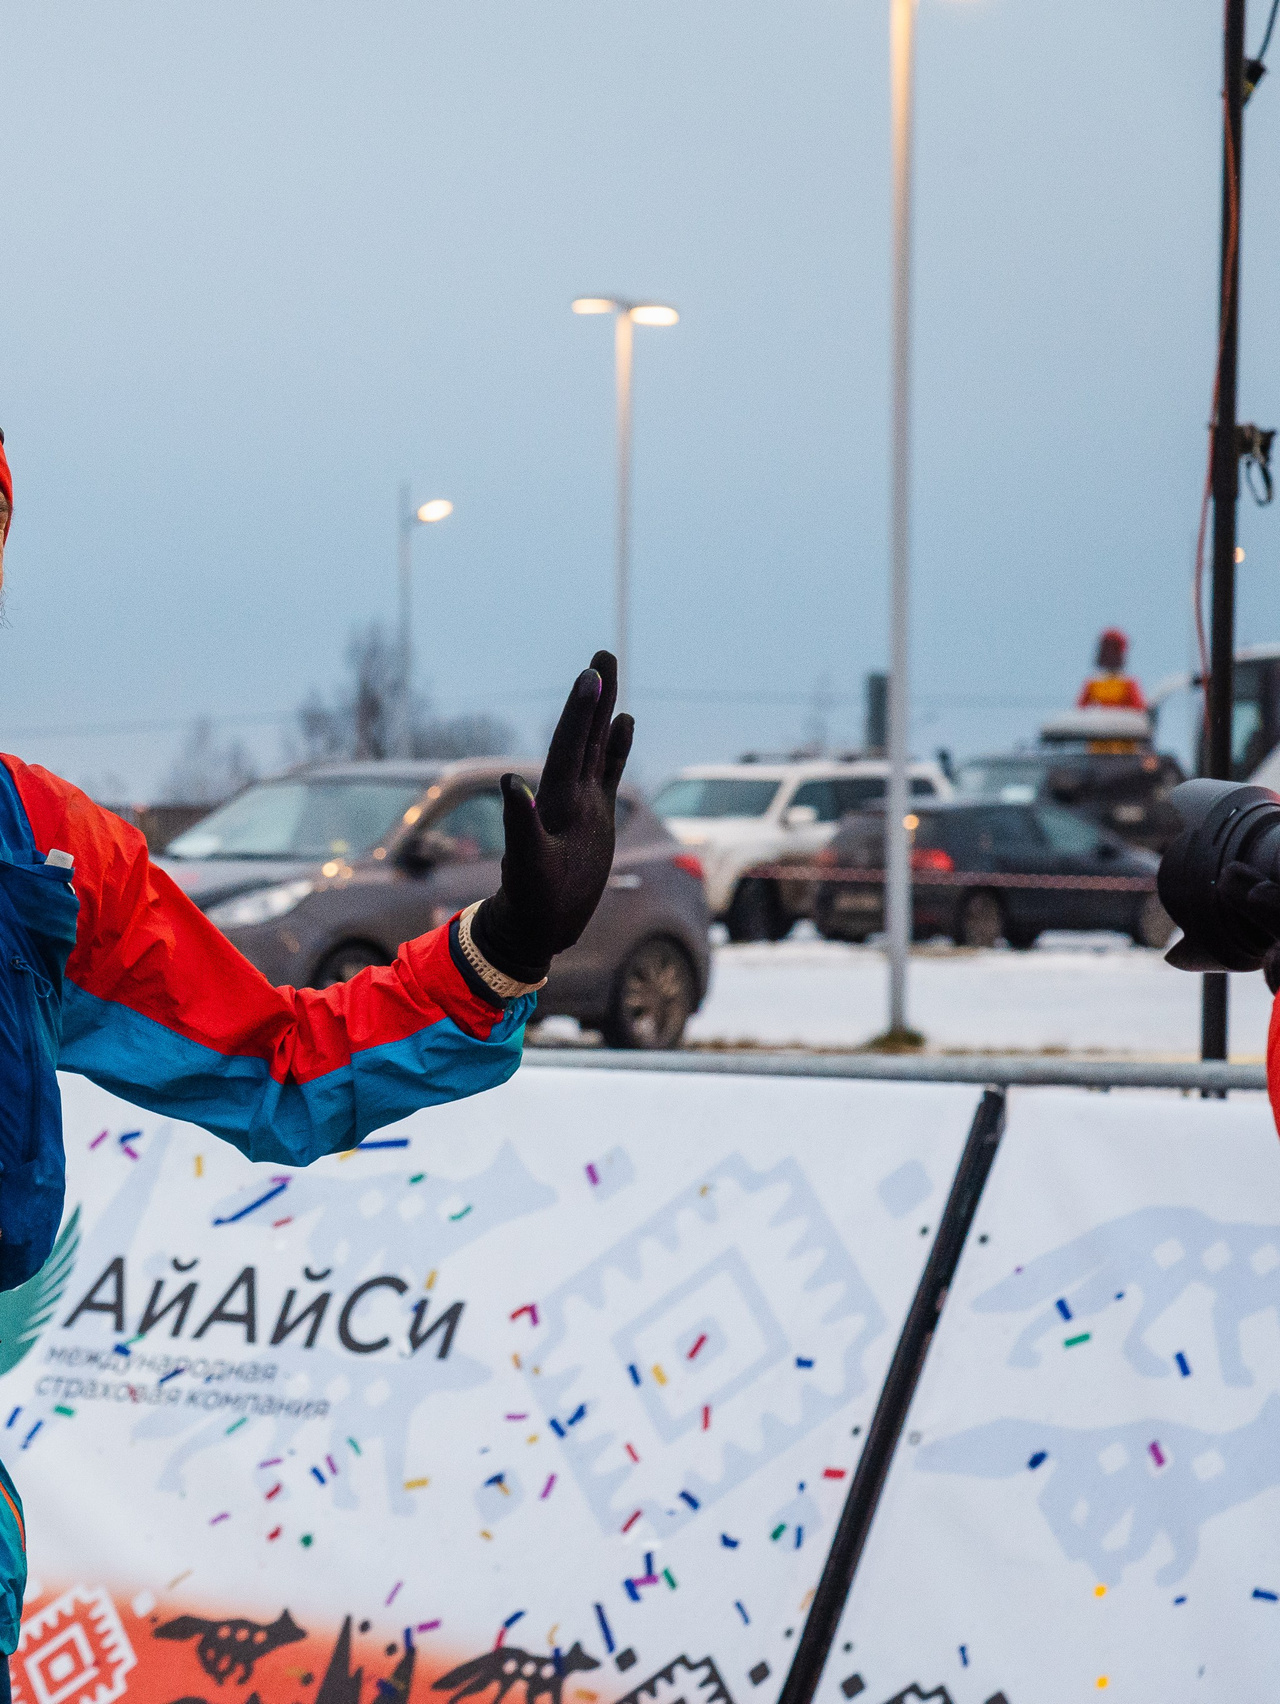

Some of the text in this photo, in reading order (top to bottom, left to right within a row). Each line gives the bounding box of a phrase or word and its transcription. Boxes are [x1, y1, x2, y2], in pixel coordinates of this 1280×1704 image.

[62, 1255, 465, 1360] АйАйСи
[35, 1374, 331, 1419] страховая компания
